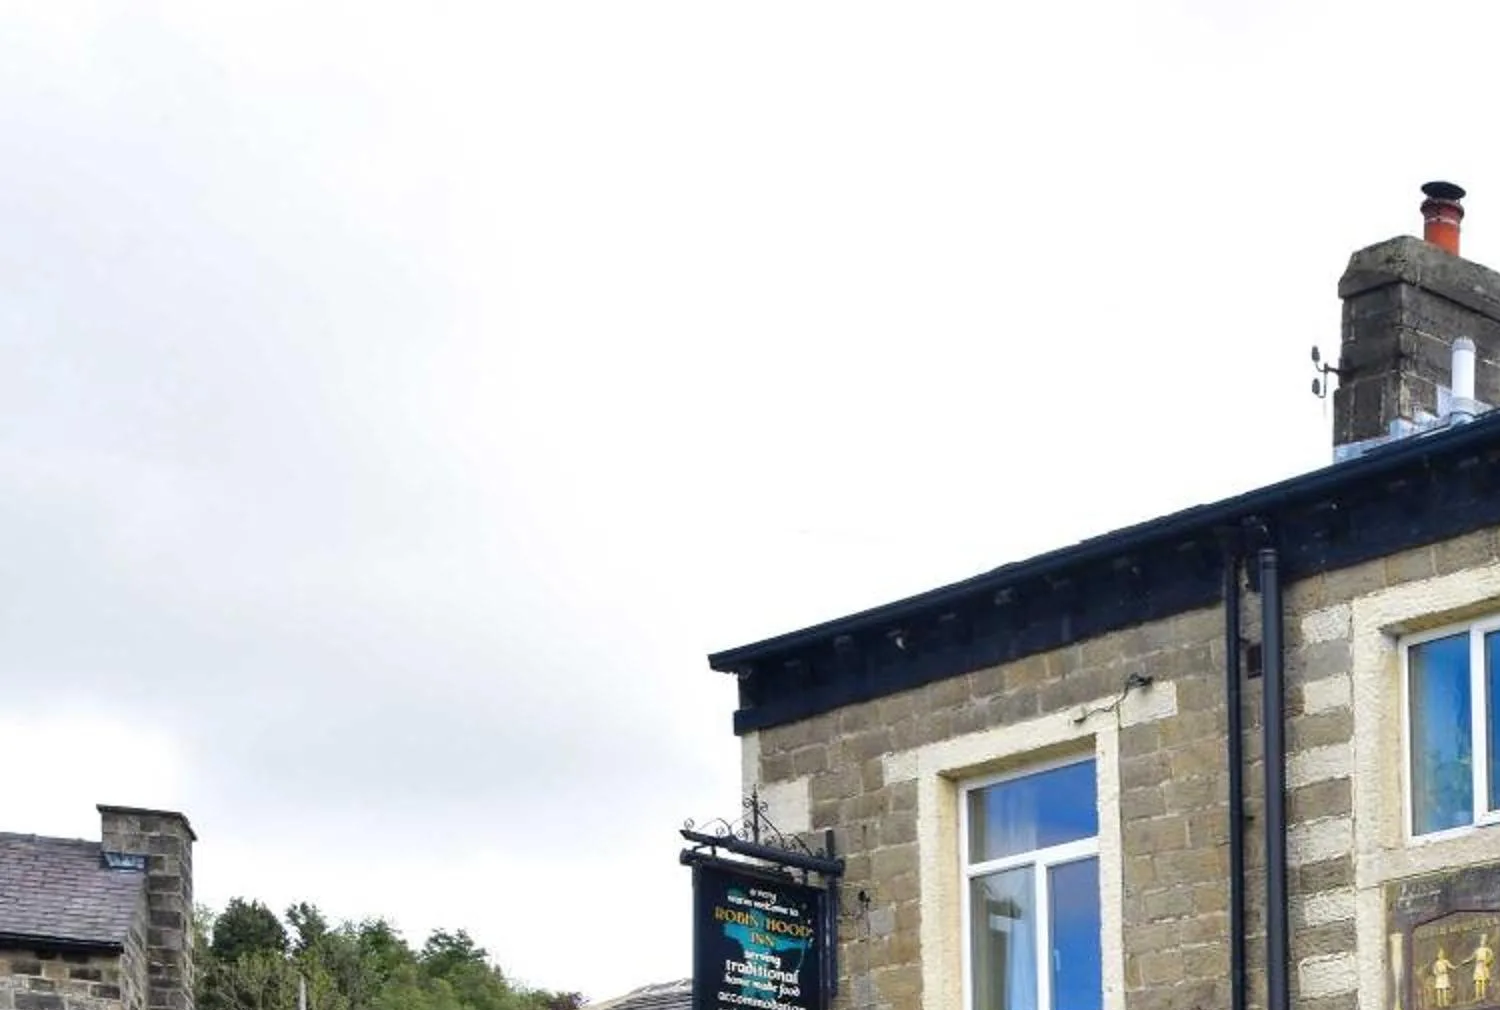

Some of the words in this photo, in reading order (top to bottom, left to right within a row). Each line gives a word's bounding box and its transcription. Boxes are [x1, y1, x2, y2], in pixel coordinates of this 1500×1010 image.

[715, 906, 759, 929] ROBIN
[766, 918, 810, 937] HOOD
[751, 932, 775, 947] INN
[744, 949, 781, 969] serving
[726, 959, 800, 984] traditional
[777, 983, 801, 999] food
